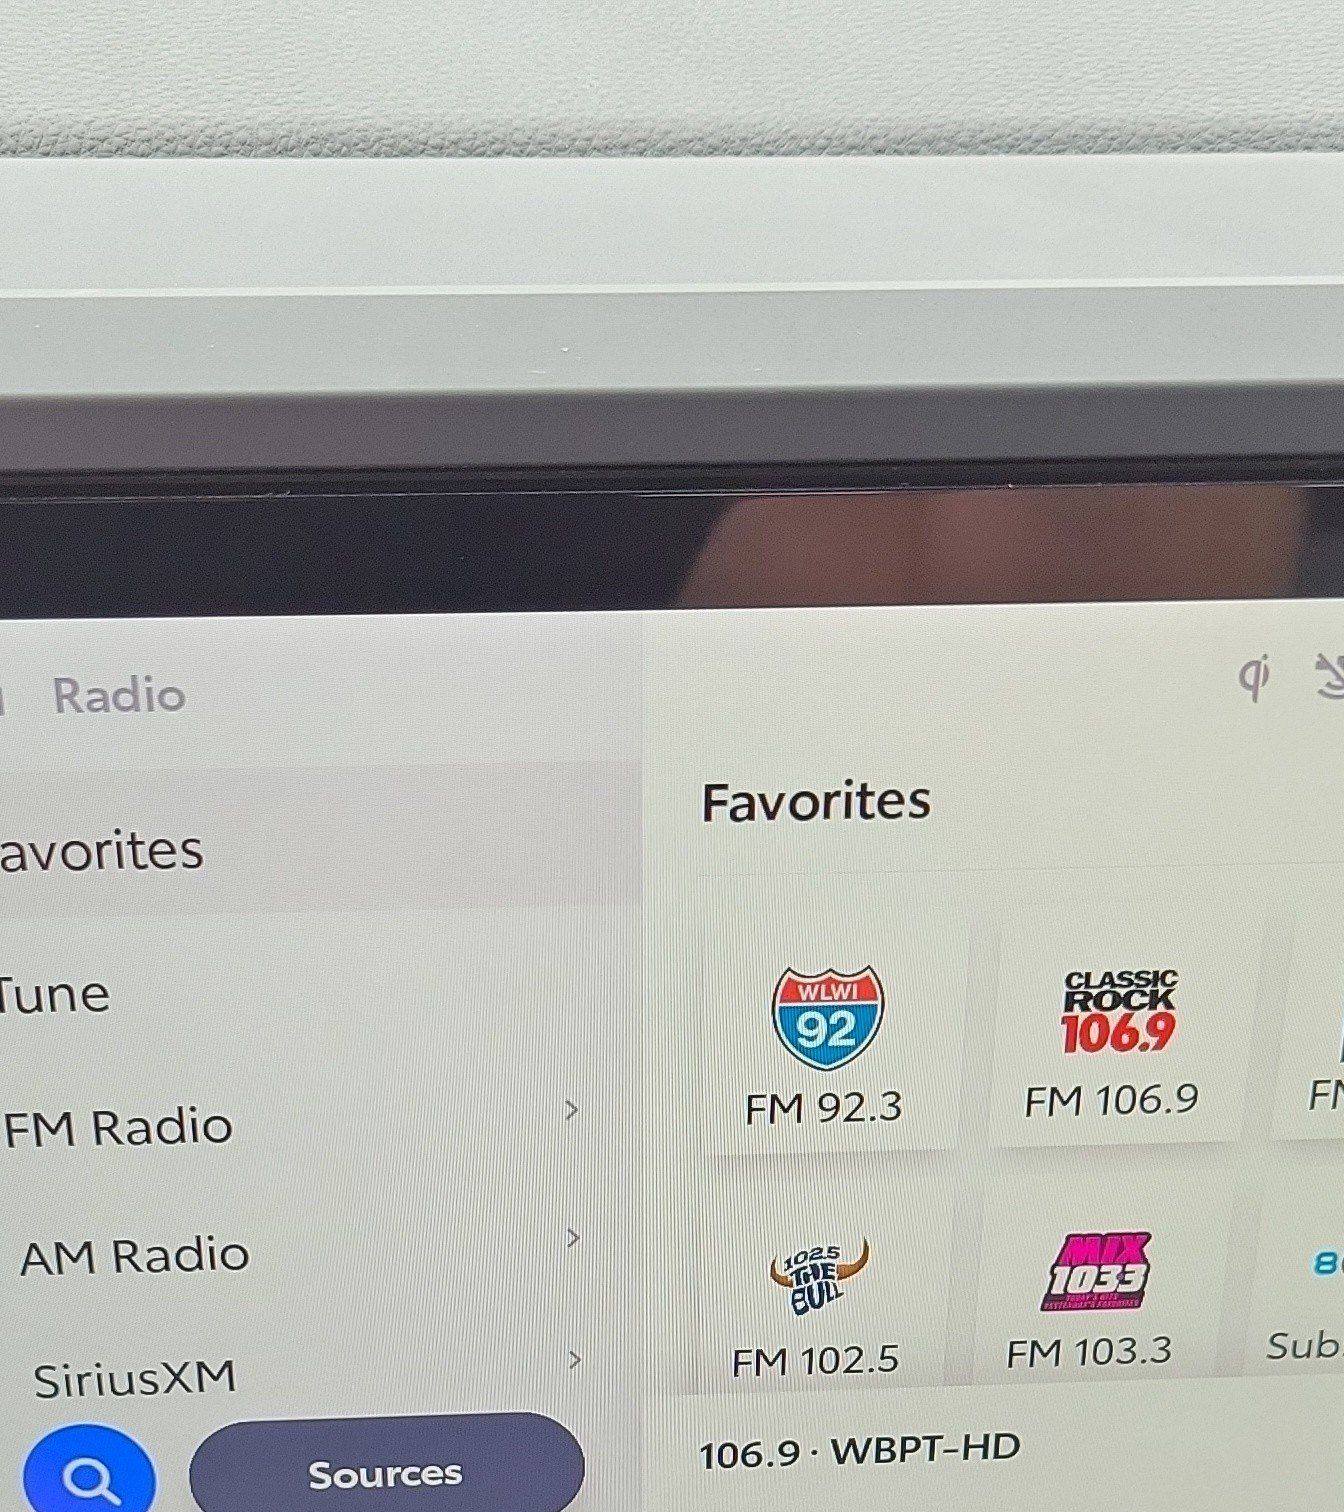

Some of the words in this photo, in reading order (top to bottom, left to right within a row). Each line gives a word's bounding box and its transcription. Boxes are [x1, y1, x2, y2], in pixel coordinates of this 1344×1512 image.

[54, 674, 186, 714] Radio
[703, 778, 932, 823] Favorites
[797, 982, 859, 1001] WLWI
[1064, 969, 1179, 990] CLASSIC
[1063, 988, 1176, 1013] ROCK
[796, 1010, 856, 1048] 92
[1060, 1011, 1177, 1053] 106.9
[747, 1093, 803, 1125] FM
[818, 1090, 902, 1123] 92.3
[1026, 1085, 1082, 1117] FM
[1097, 1083, 1198, 1116] 106.9
[5, 1111, 75, 1148] FM
[93, 1105, 233, 1146] Radio
[20, 1240, 96, 1277] AM
[113, 1234, 250, 1273] Radio
[783, 1246, 841, 1272] 102.5
[1058, 1233, 1152, 1265] MIX
[789, 1262, 836, 1287] THE
[791, 1280, 845, 1316] BULL
[733, 1347, 787, 1377] FM
[801, 1344, 899, 1375] 102.5
[1007, 1339, 1061, 1368] FM
[1075, 1336, 1171, 1366] 103.3
[34, 1359, 236, 1399] SiriusXM
[700, 1439, 800, 1470] 106.9
[830, 1432, 1021, 1465] WBPT-HD
[309, 1461, 464, 1490] Sources
